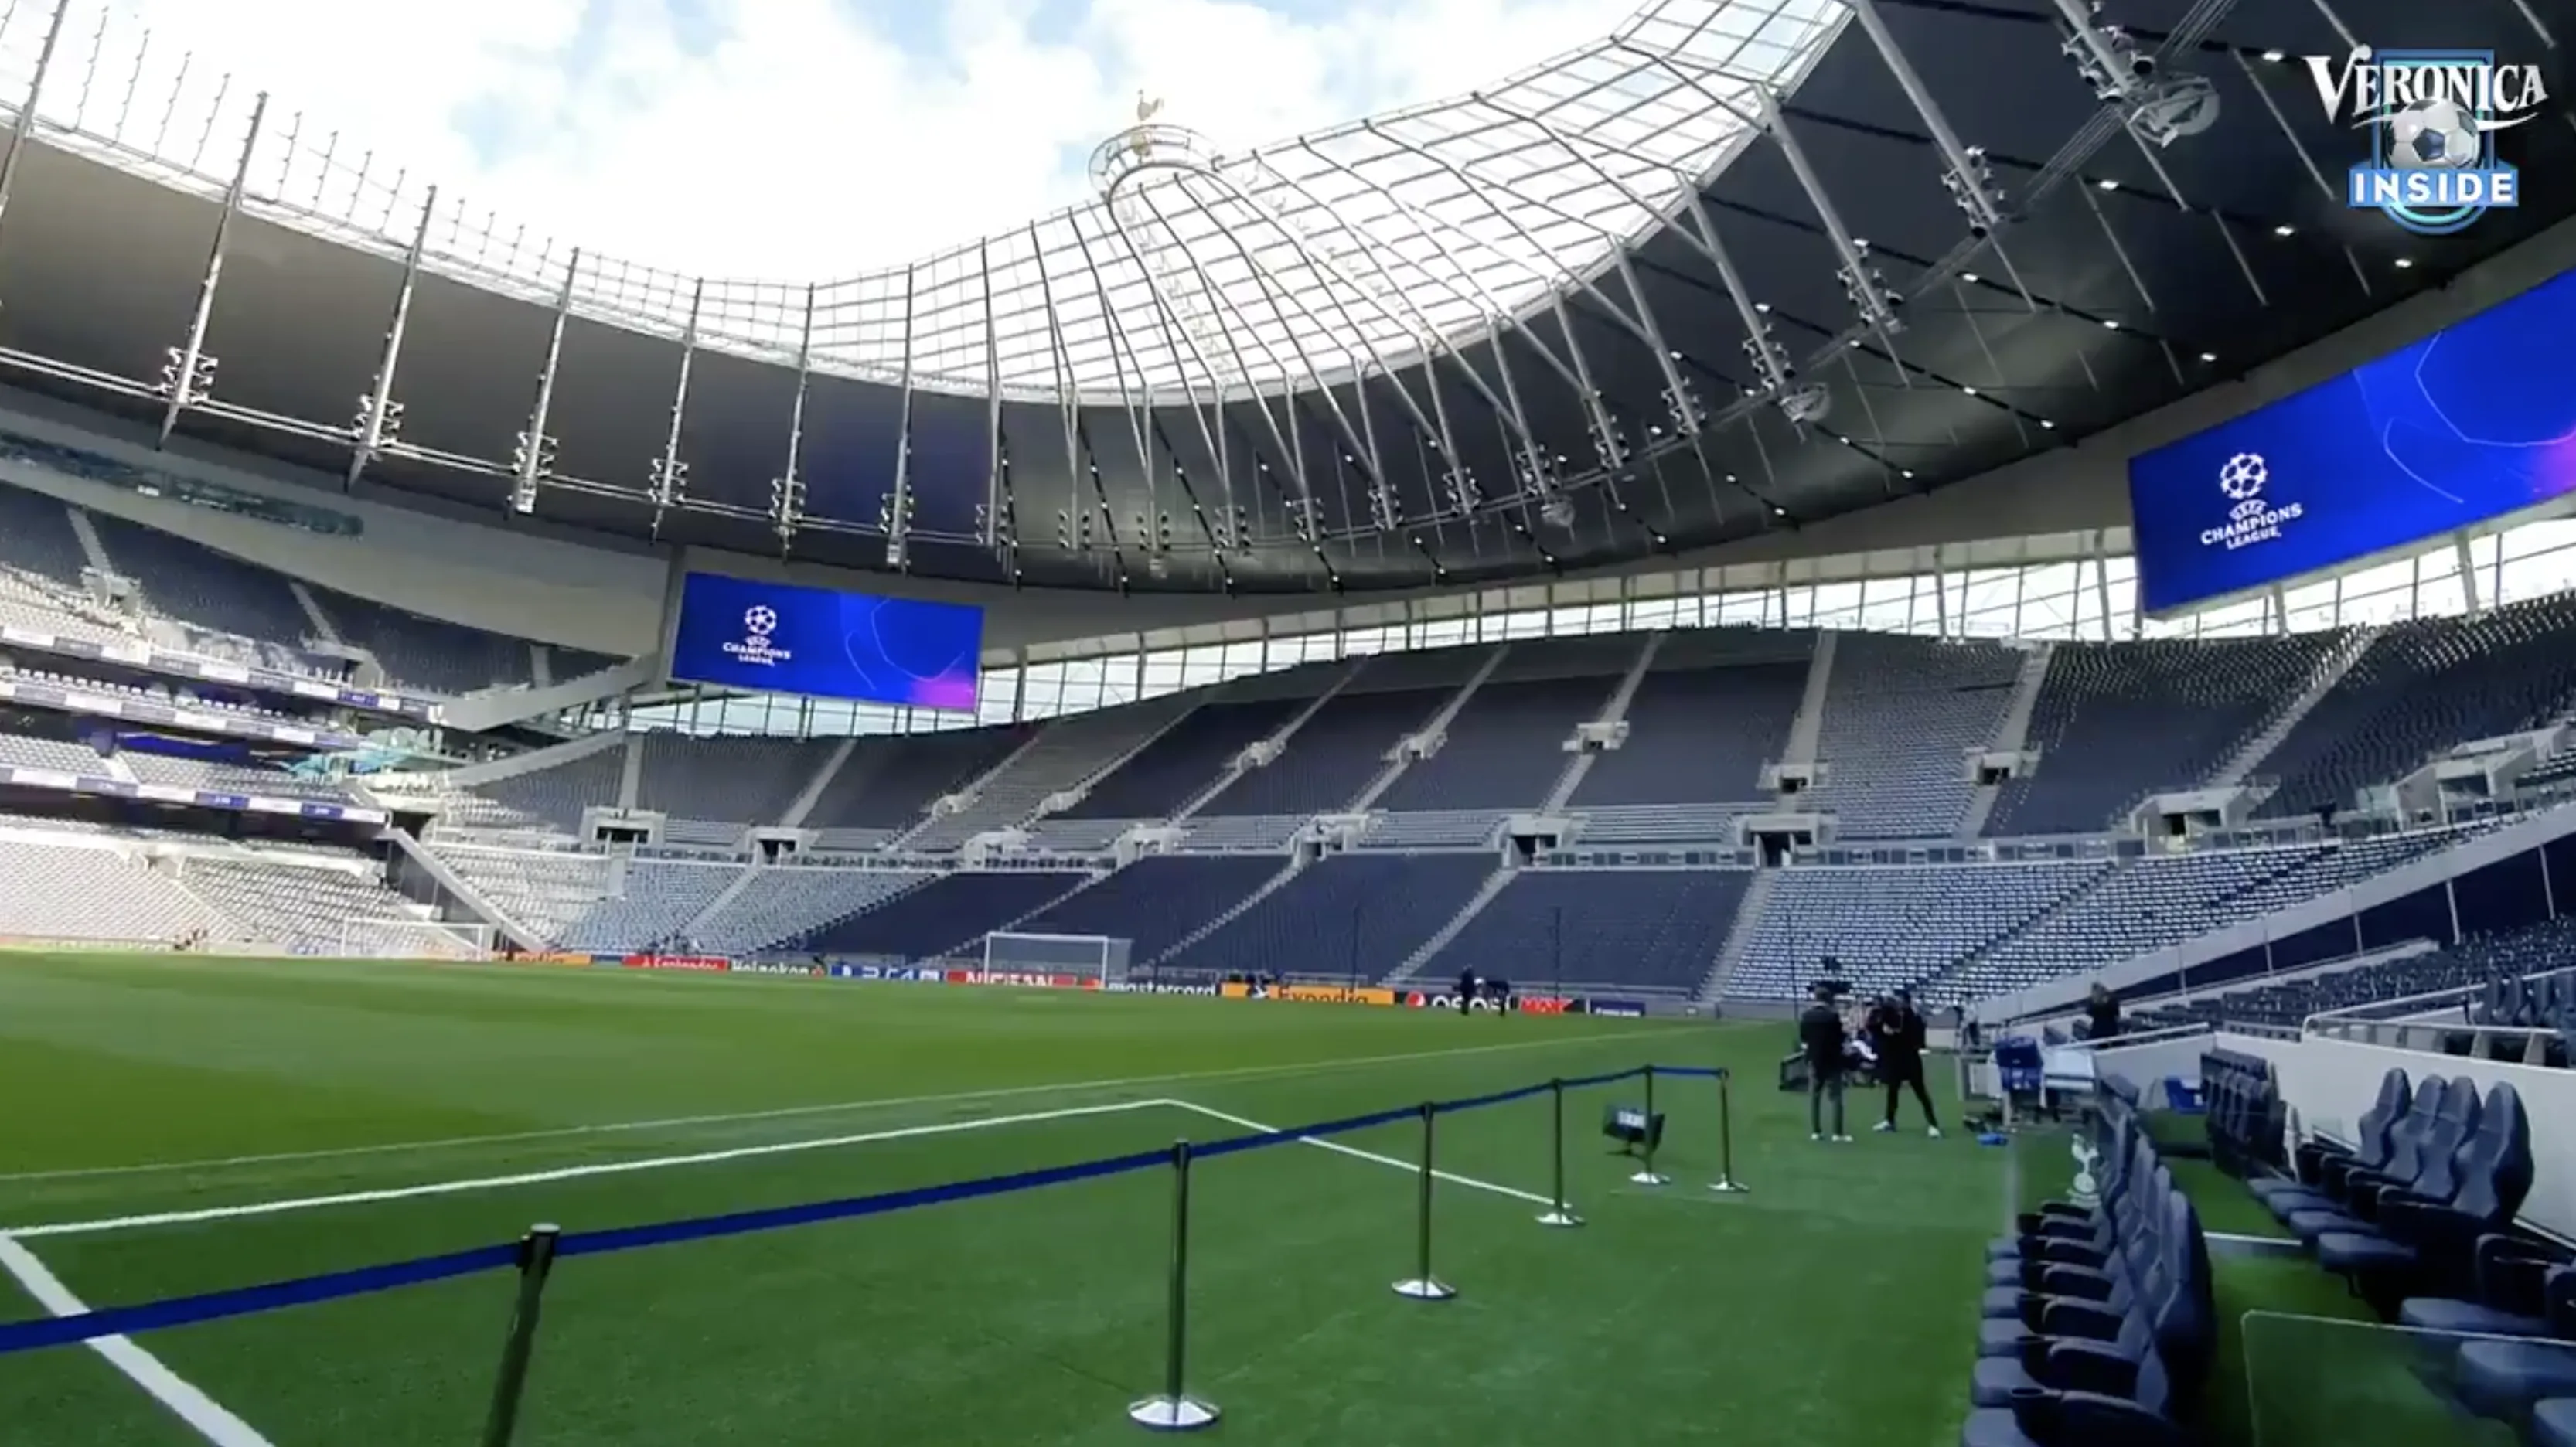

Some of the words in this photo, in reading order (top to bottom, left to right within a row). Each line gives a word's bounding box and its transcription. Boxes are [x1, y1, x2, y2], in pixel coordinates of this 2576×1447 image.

[2201, 502, 2303, 546] CHAMPIONS
[2226, 525, 2280, 550] LEAGUE
[722, 642, 792, 660] CHAMPIONS
